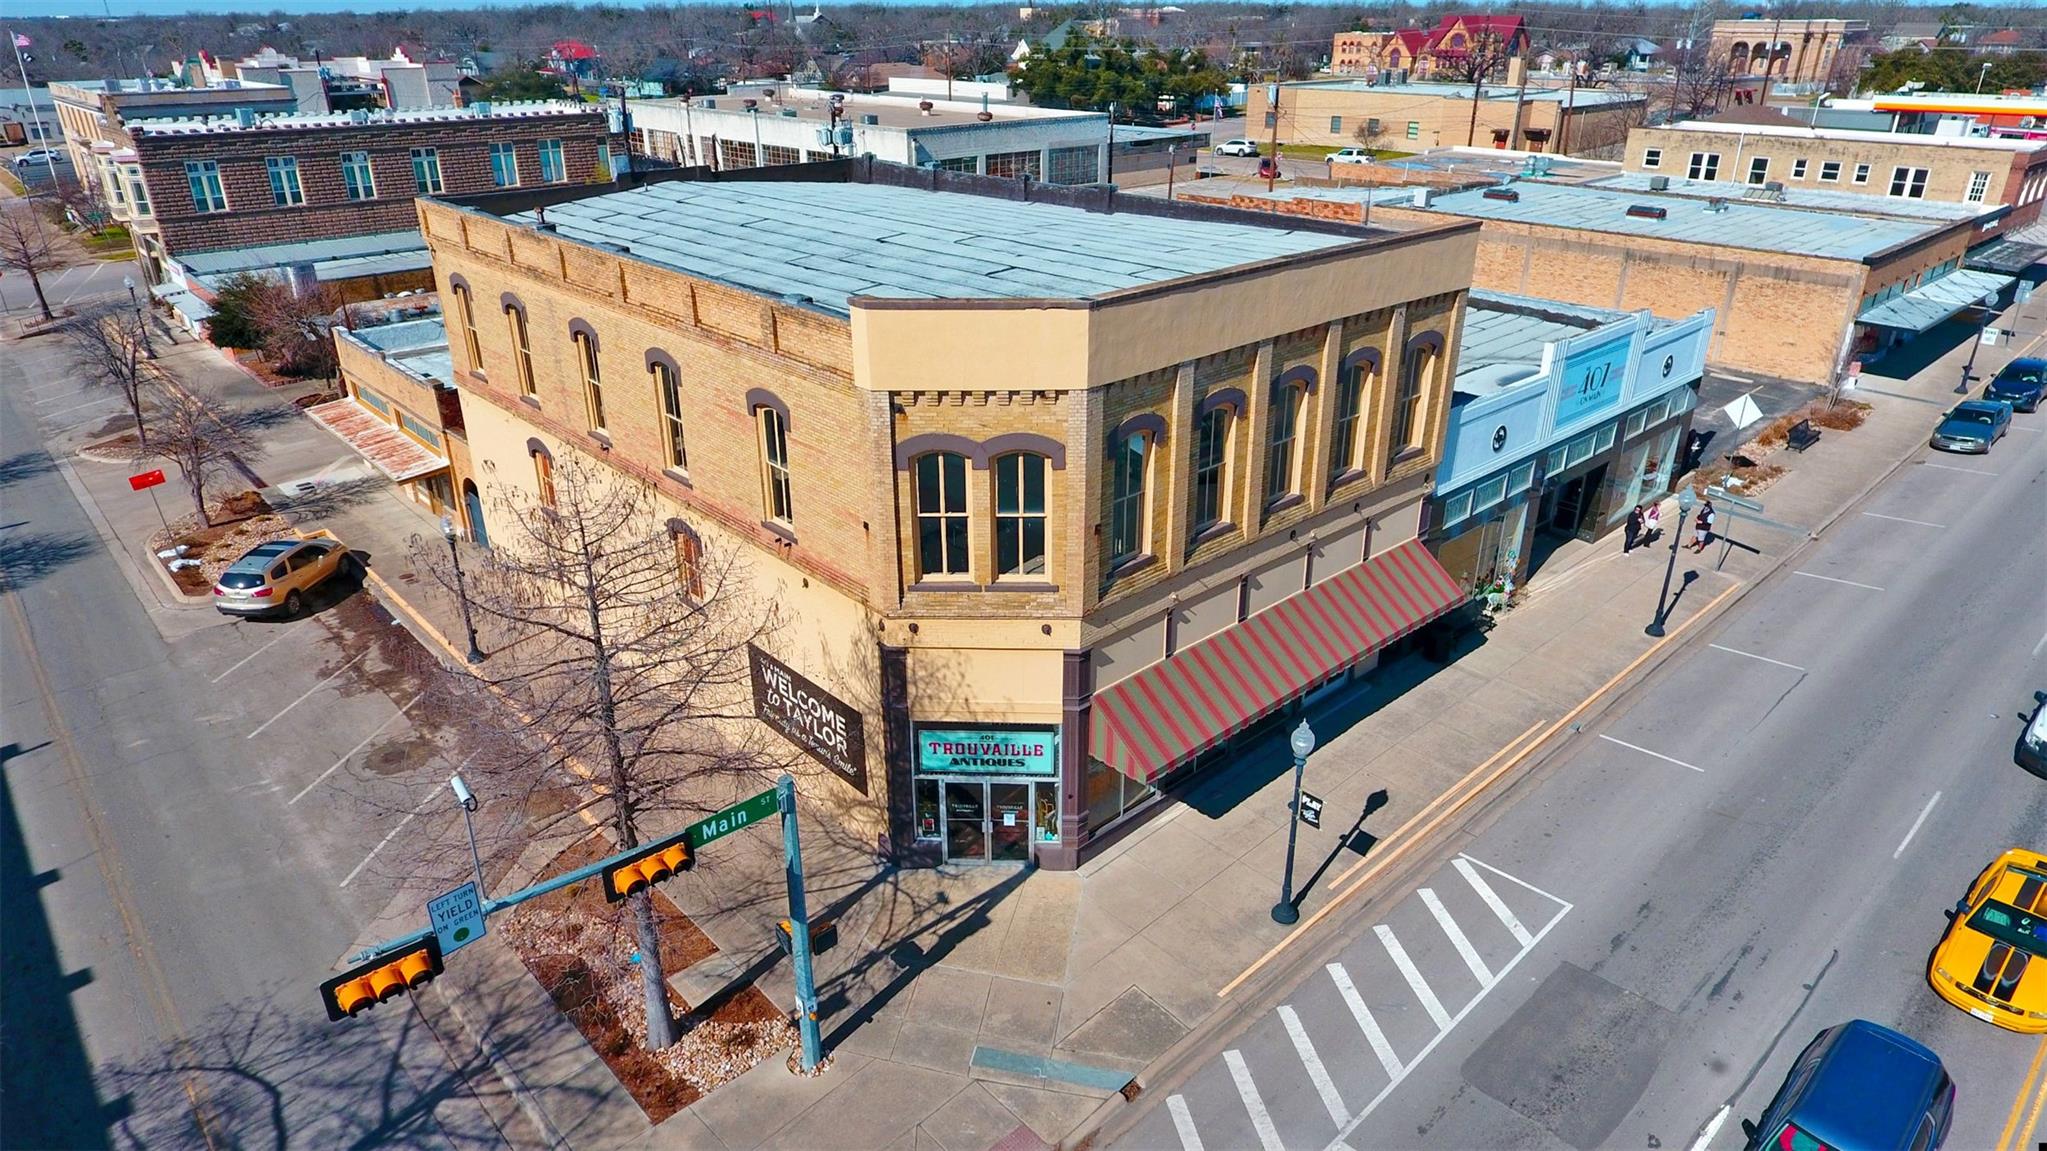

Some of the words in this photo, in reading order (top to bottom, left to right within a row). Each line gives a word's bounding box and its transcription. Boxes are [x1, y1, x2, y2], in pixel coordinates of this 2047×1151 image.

[1578, 362, 1612, 395] 407
[761, 665, 847, 738] WELCOME
[767, 688, 780, 706] to
[783, 697, 848, 758] TAYLOR
[928, 742, 1044, 757] TROUVAILLE
[949, 757, 1026, 768] ANTIQUES
[702, 810, 747, 840] Main
[760, 795, 770, 806] ST
[432, 899, 450, 912] LEFT
[453, 888, 474, 901] TURN
[437, 899, 473, 922] YIELD
[437, 924, 449, 934] ON
[453, 909, 479, 926] GREEN
